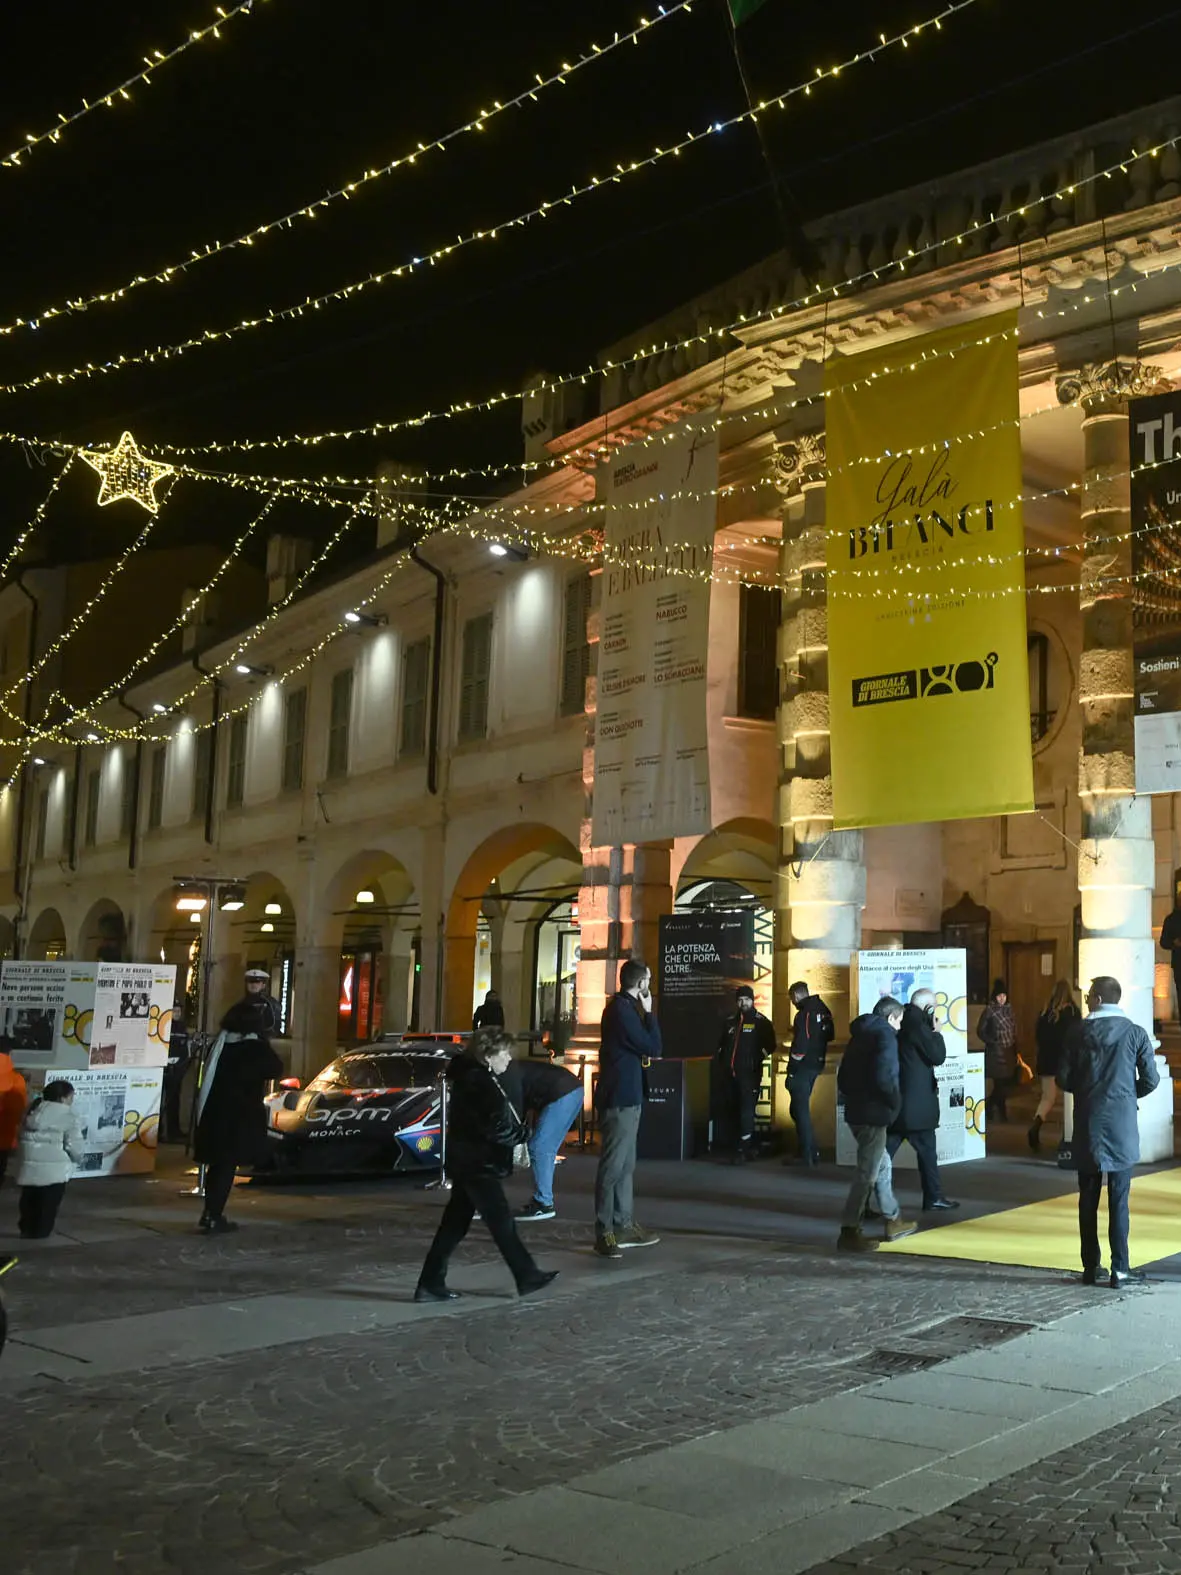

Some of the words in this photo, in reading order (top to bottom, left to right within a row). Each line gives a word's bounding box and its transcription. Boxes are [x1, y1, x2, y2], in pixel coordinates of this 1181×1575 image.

[1139, 658, 1180, 674] Sostieni
[860, 675, 908, 692] GIORNALE
[858, 692, 868, 702] DI
[870, 686, 911, 701] BRESCIA
[665, 945, 676, 954] LA
[677, 944, 715, 954] POTENZA
[665, 955, 682, 964] CHE
[683, 954, 691, 963] CI
[693, 953, 721, 963] PORTA
[665, 964, 693, 974] OLTRE.
